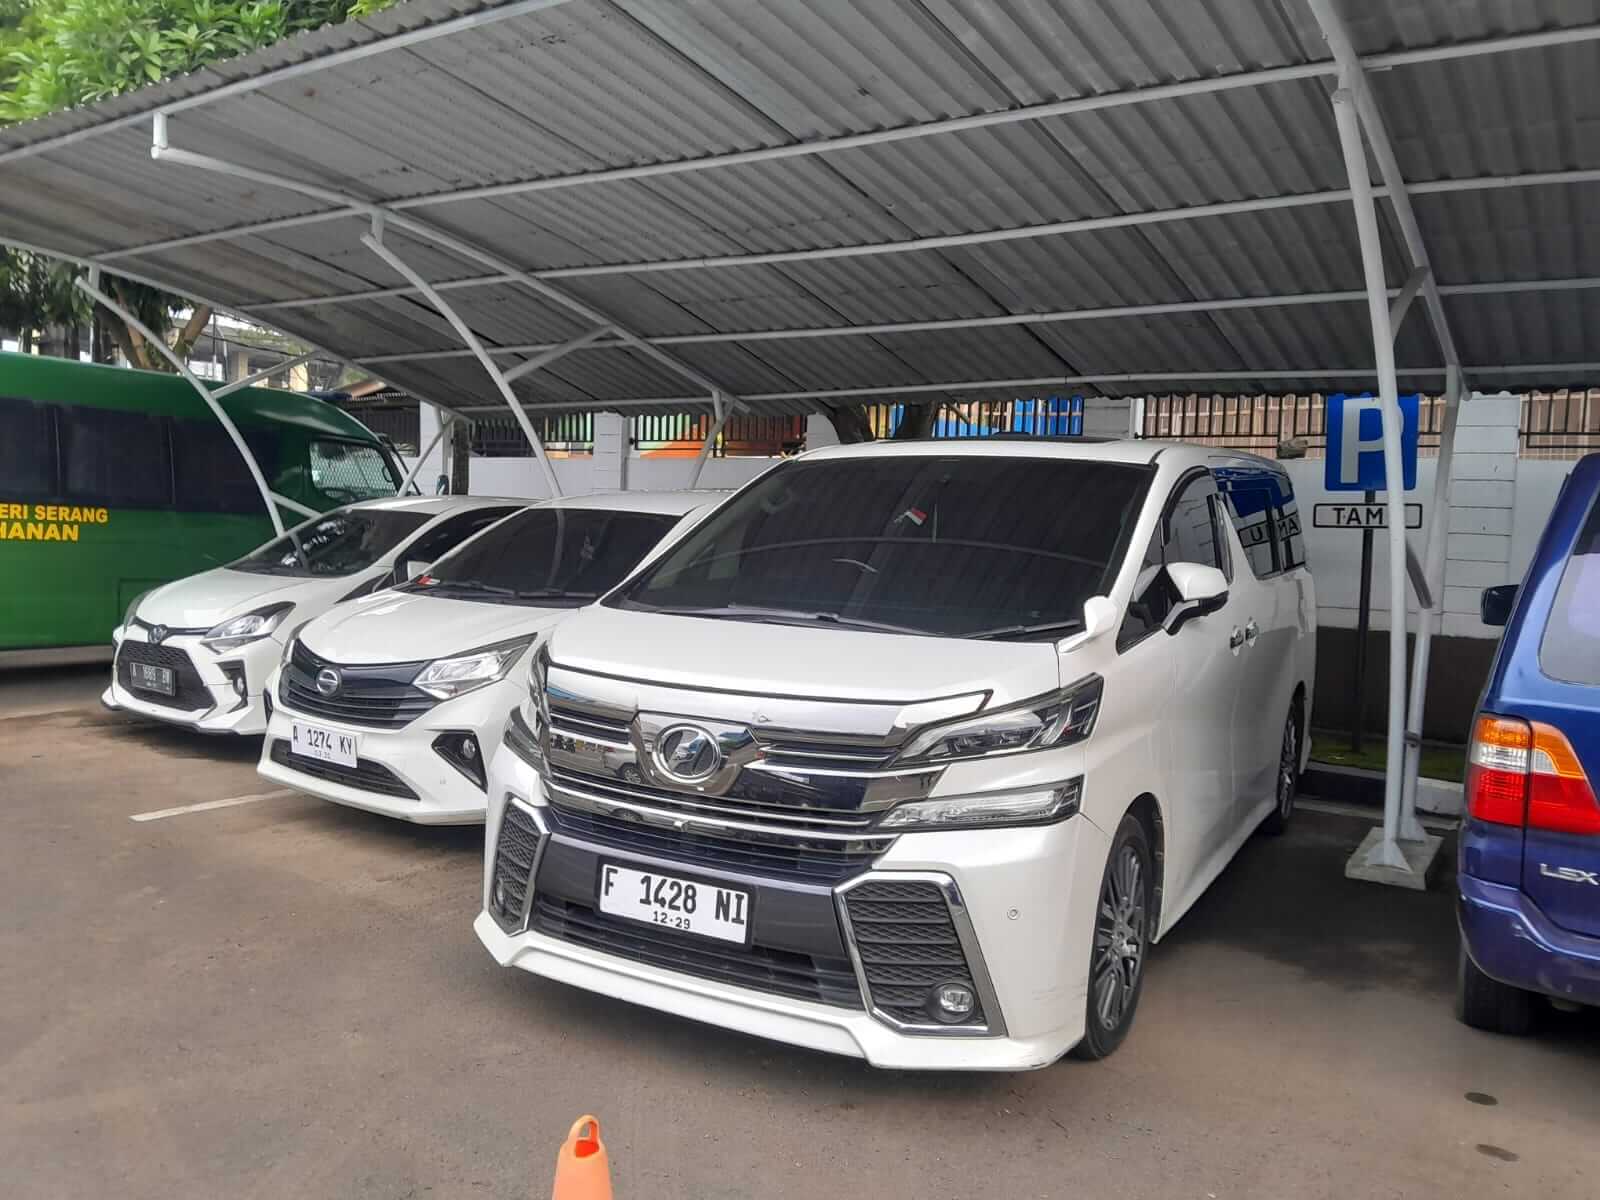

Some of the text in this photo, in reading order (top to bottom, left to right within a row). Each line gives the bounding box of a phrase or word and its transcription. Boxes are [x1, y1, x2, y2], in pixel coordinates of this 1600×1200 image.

[1341, 397, 1404, 483] P
[34, 504, 108, 523] SERANG
[1332, 507, 1384, 525] TAM
[293, 725, 299, 743] A
[307, 728, 332, 750] 1274
[340, 735, 352, 755] KY
[604, 867, 745, 925] F 1428 NI
